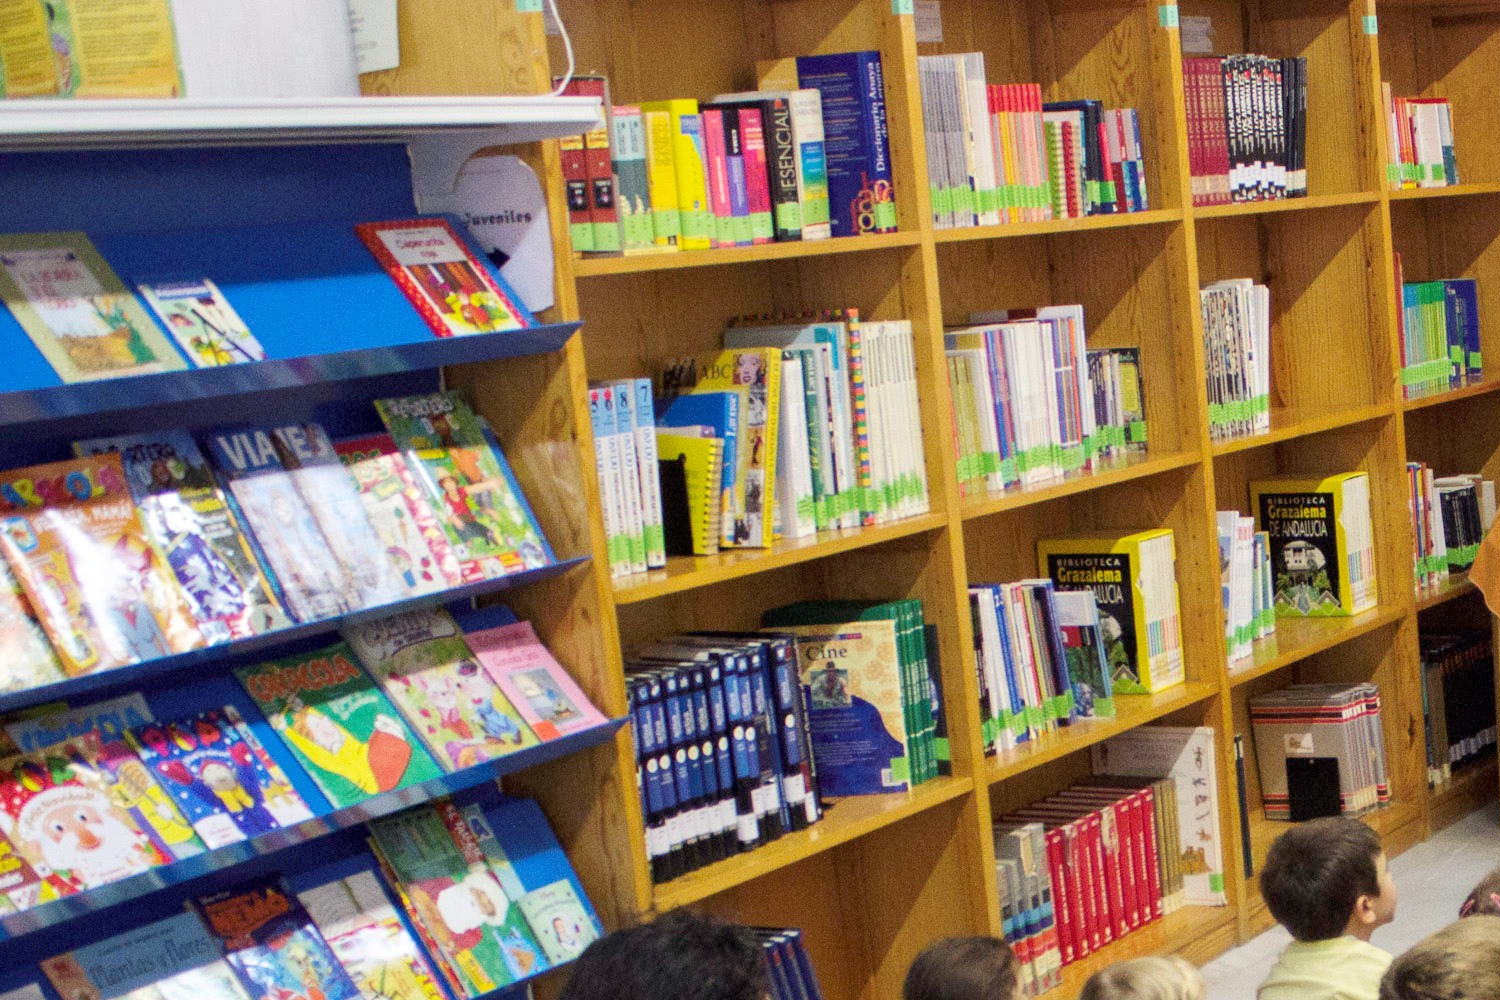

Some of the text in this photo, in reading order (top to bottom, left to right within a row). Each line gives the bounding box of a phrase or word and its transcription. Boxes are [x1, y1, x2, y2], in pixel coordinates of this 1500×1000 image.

[866, 62, 886, 172] Diccionario Anaya
[773, 110, 796, 188] ESENCIAL
[463, 210, 532, 227] Juveniles
[699, 362, 733, 384] ABC
[1267, 496, 1325, 505] BIBLIOTECA
[1268, 504, 1326, 519] Grazalema
[1269, 520, 1280, 537] DE
[1056, 558, 1121, 567] BIBLIOTECA
[1057, 567, 1122, 583] Grazalema
[806, 644, 848, 662] Cine
